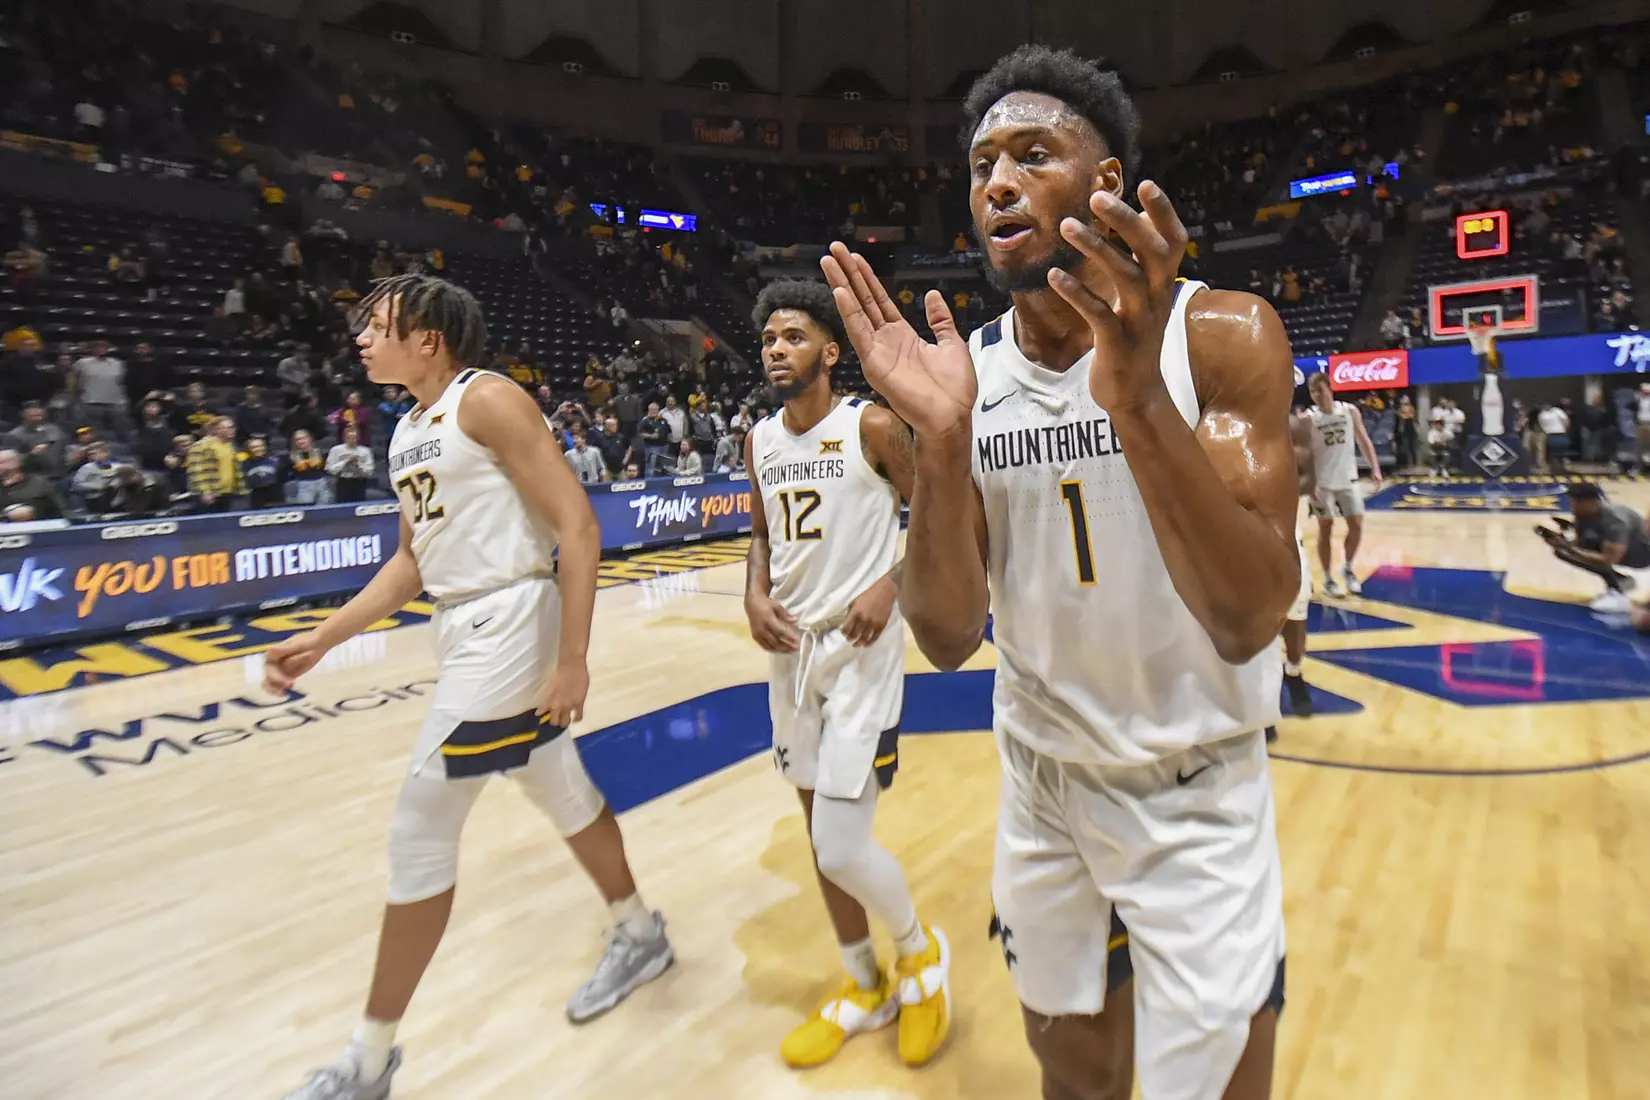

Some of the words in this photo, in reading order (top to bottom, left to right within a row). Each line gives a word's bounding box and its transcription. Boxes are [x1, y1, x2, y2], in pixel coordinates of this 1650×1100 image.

[978, 418, 1123, 473] MOUNTAINEE
[1324, 428, 1346, 446] 22
[389, 438, 441, 473] OUNTAINEERS
[611, 481, 646, 492] GEICO
[673, 477, 704, 487] GEICO
[761, 459, 844, 487] MOUNTAINEERS
[101, 521, 179, 540] GEICO
[239, 510, 304, 527] GEICO
[778, 488, 822, 542] 12
[1060, 480, 1097, 585] 1
[171, 552, 229, 590] FOR
[235, 534, 382, 581] ATTENDING!
[77, 682, 437, 779] Medicin
